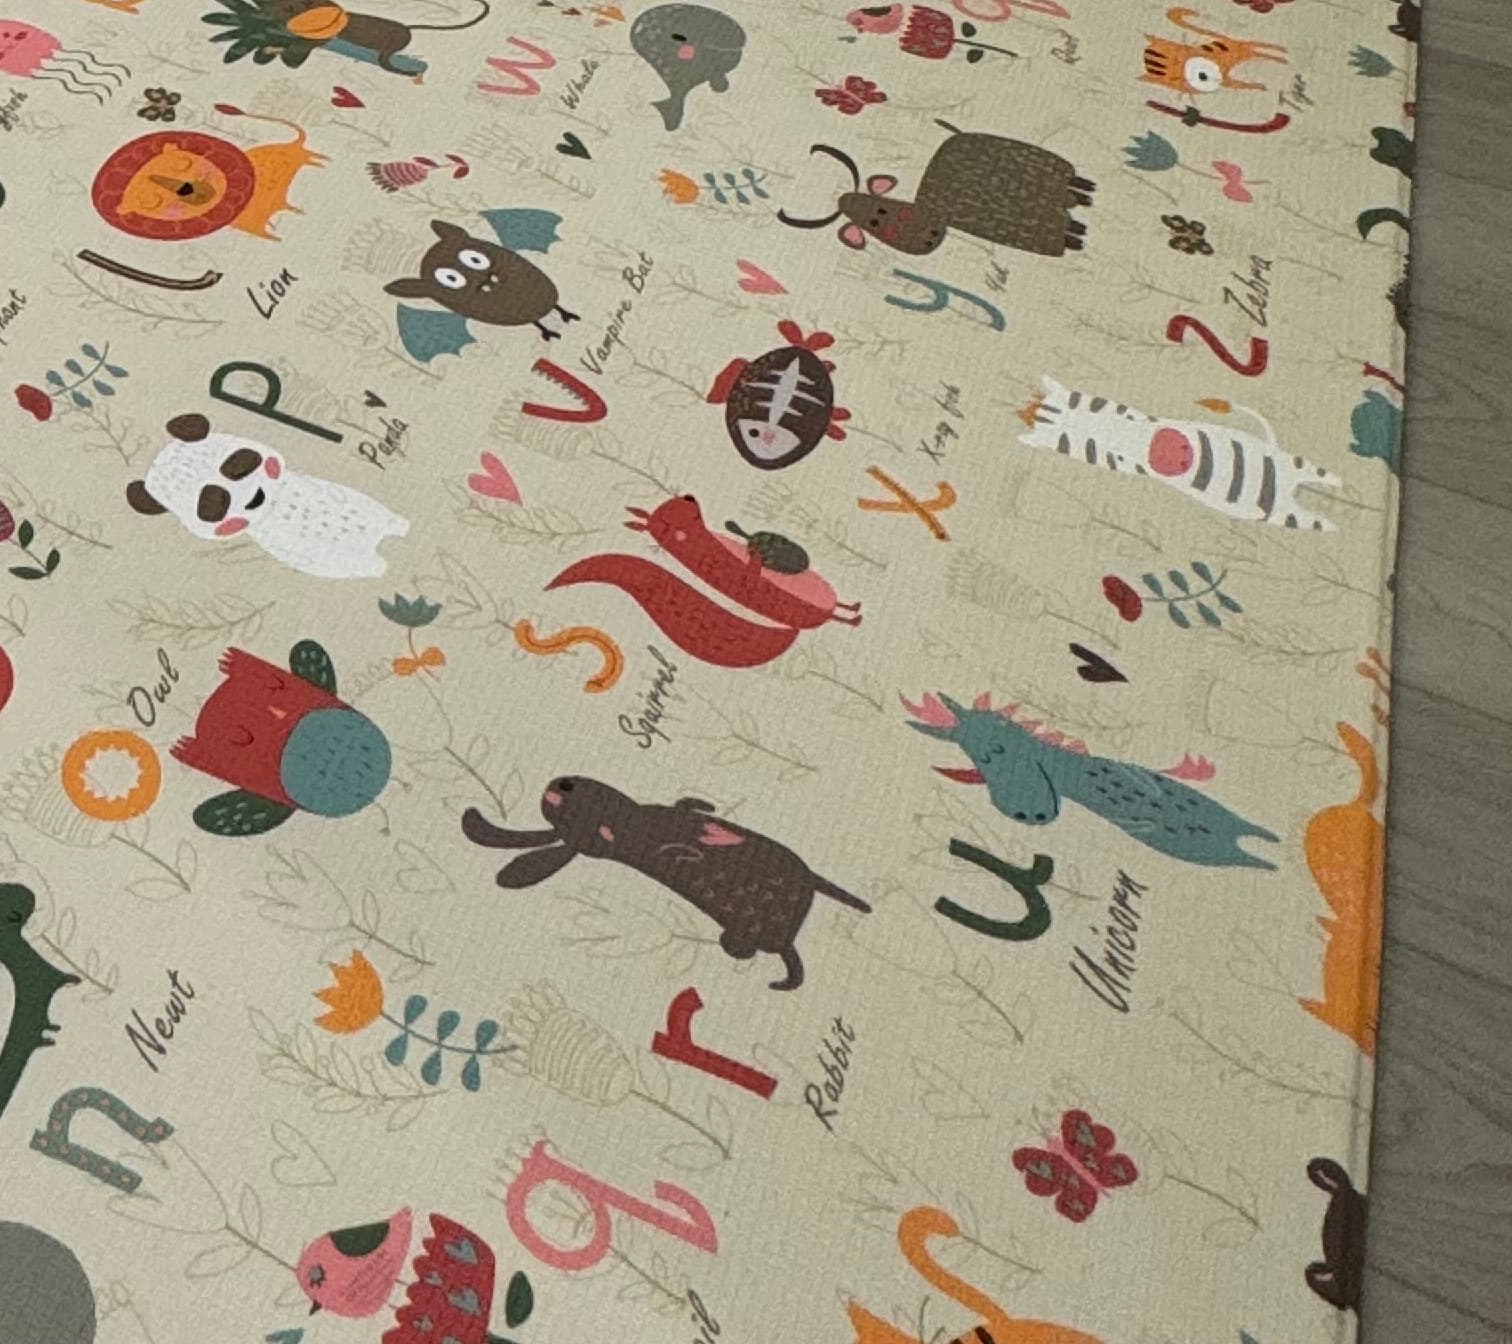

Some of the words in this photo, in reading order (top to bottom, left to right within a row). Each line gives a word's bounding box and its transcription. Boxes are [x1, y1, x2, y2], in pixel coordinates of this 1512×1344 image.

[246, 269, 299, 321] Lion
[580, 298, 633, 376] Vampire
[622, 251, 655, 295] Bat
[884, 268, 1006, 332] y
[1223, 254, 1273, 328] Zebra
[209, 360, 343, 444] p
[357, 415, 410, 473] Panda
[126, 648, 181, 728] Owl
[618, 643, 678, 750] Squirrel
[934, 838, 1055, 942] u
[1068, 869, 1150, 1014] Unicorn
[124, 968, 197, 1073] Newt
[650, 986, 779, 1100] r
[802, 1014, 859, 1133] Rabbit
[29, 1085, 175, 1195] n
